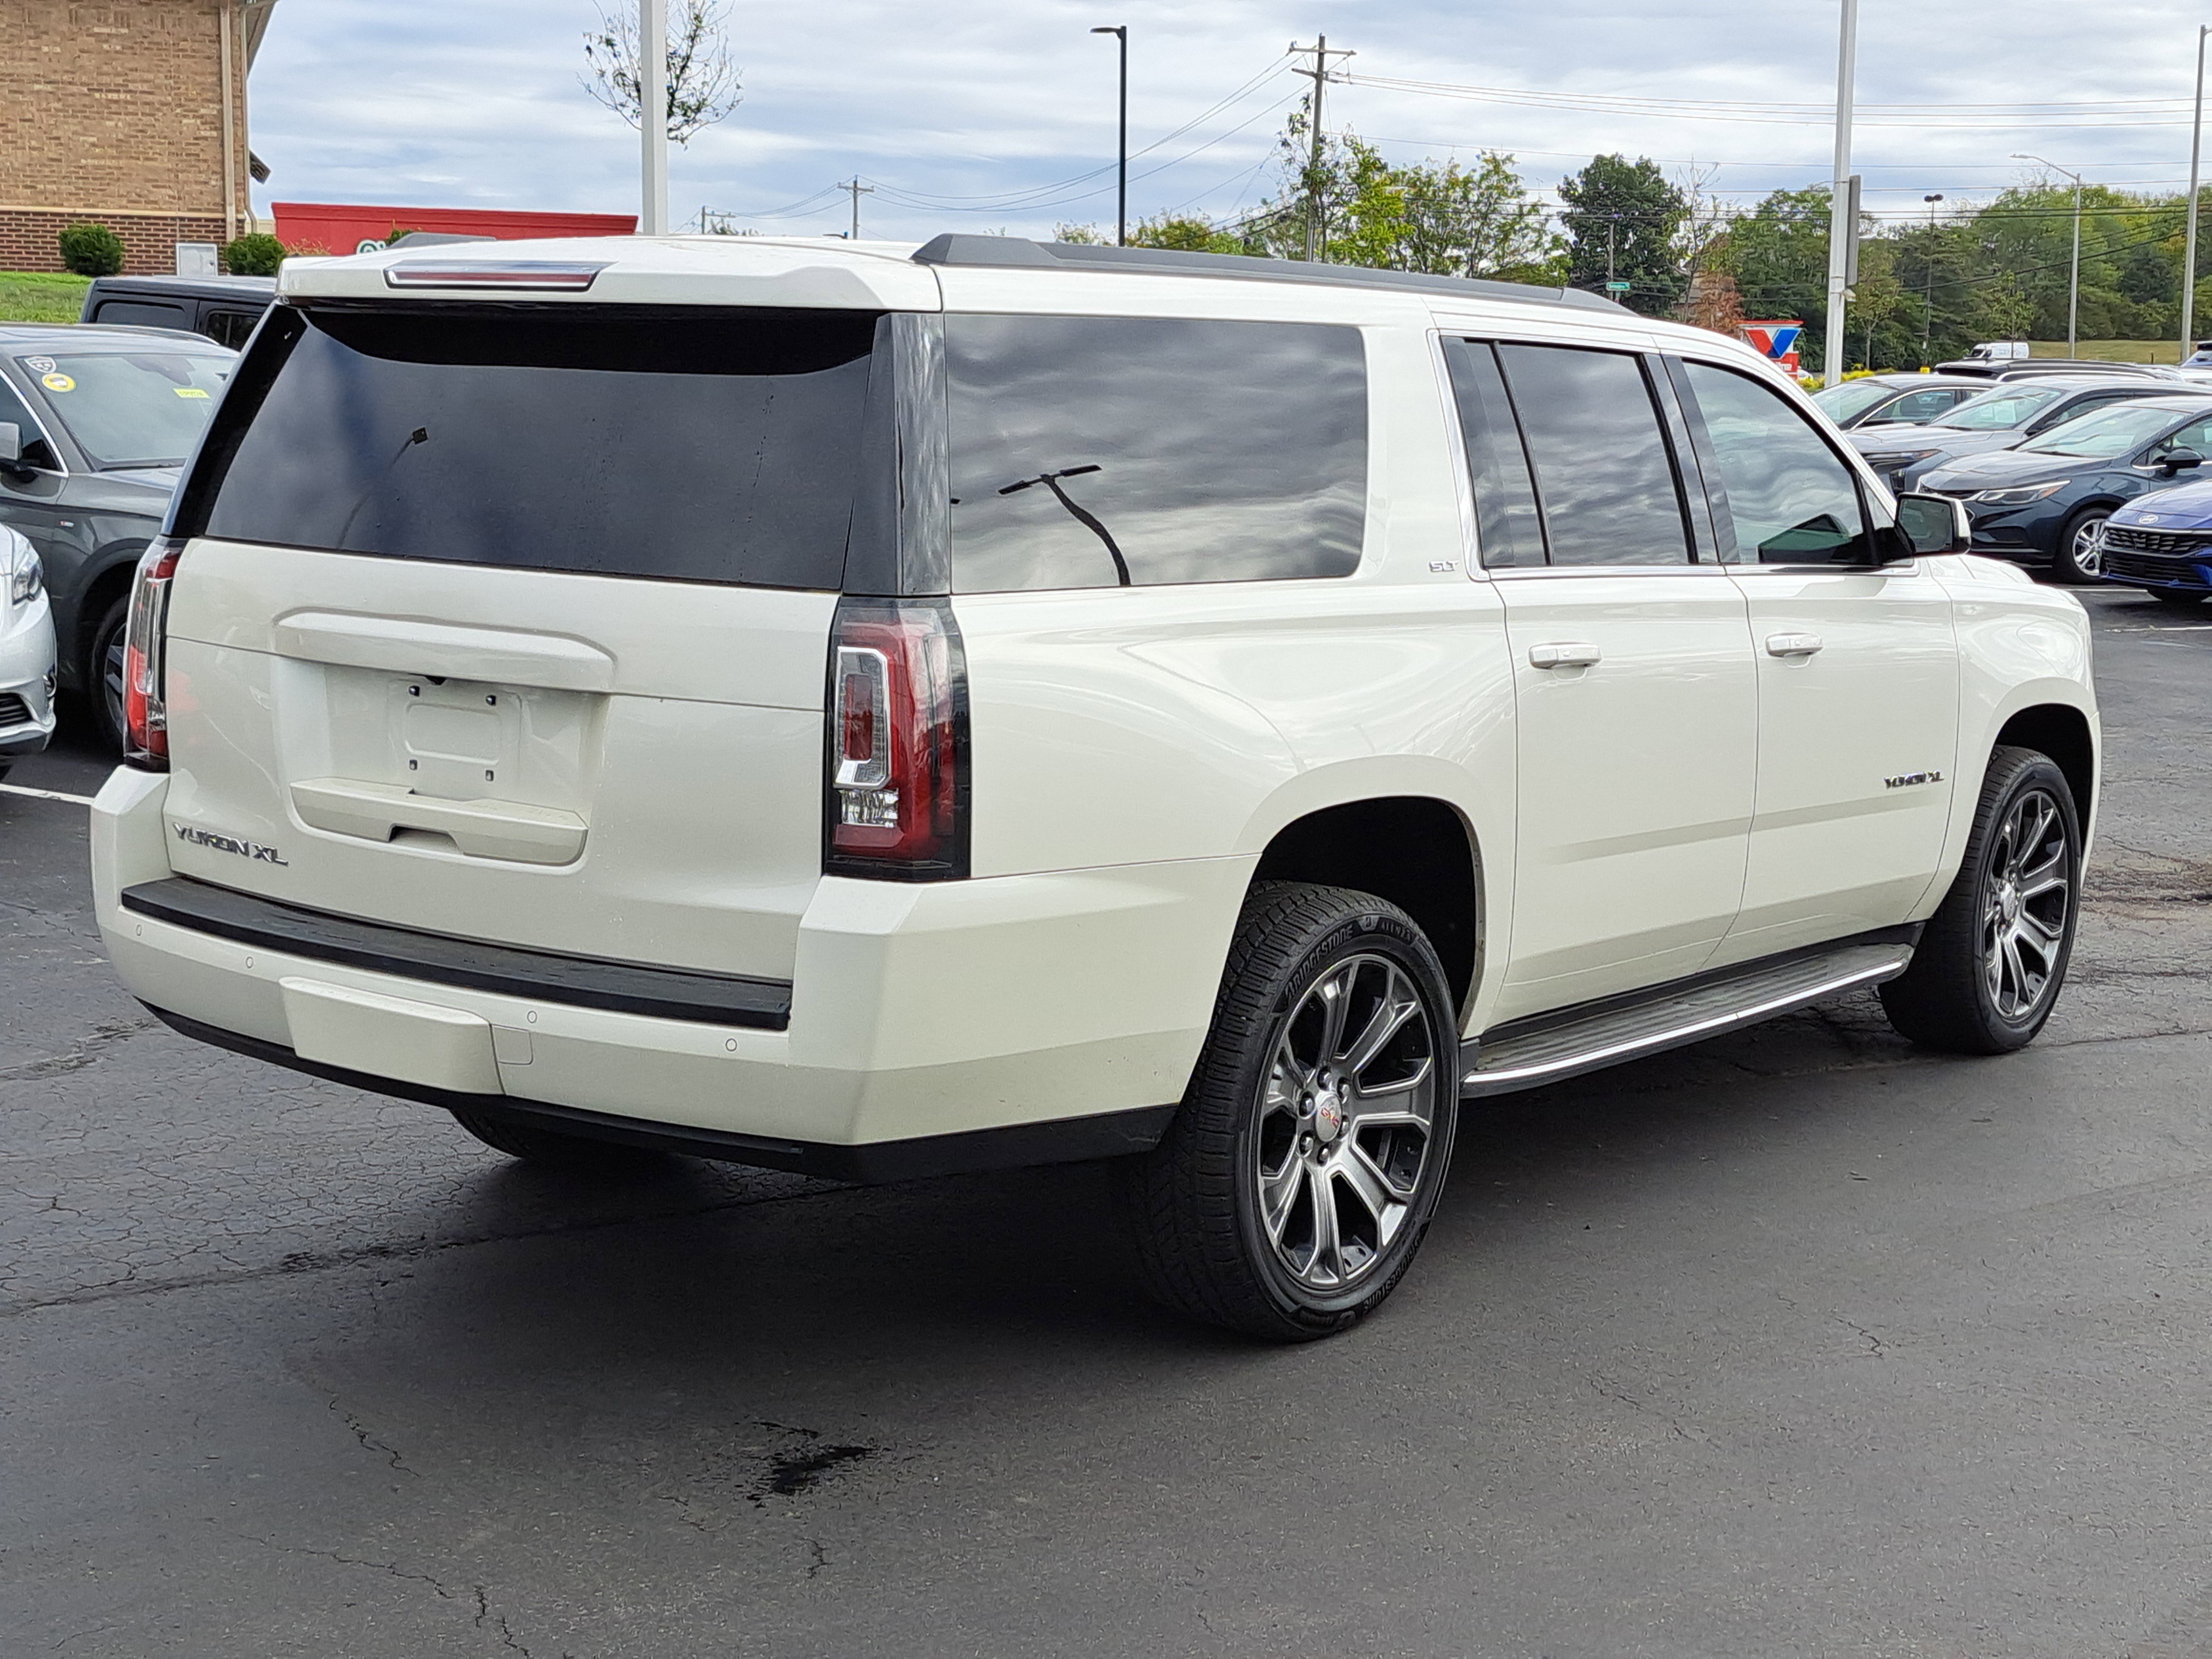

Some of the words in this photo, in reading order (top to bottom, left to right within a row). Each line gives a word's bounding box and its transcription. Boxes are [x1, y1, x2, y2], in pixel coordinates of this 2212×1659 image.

[1428, 560, 1459, 573] SLT
[172, 822, 250, 857] YUKON
[250, 842, 289, 867] XL
[1284, 923, 1354, 997] BRIDGESTONE
[1320, 1107, 1339, 1129] GMC
